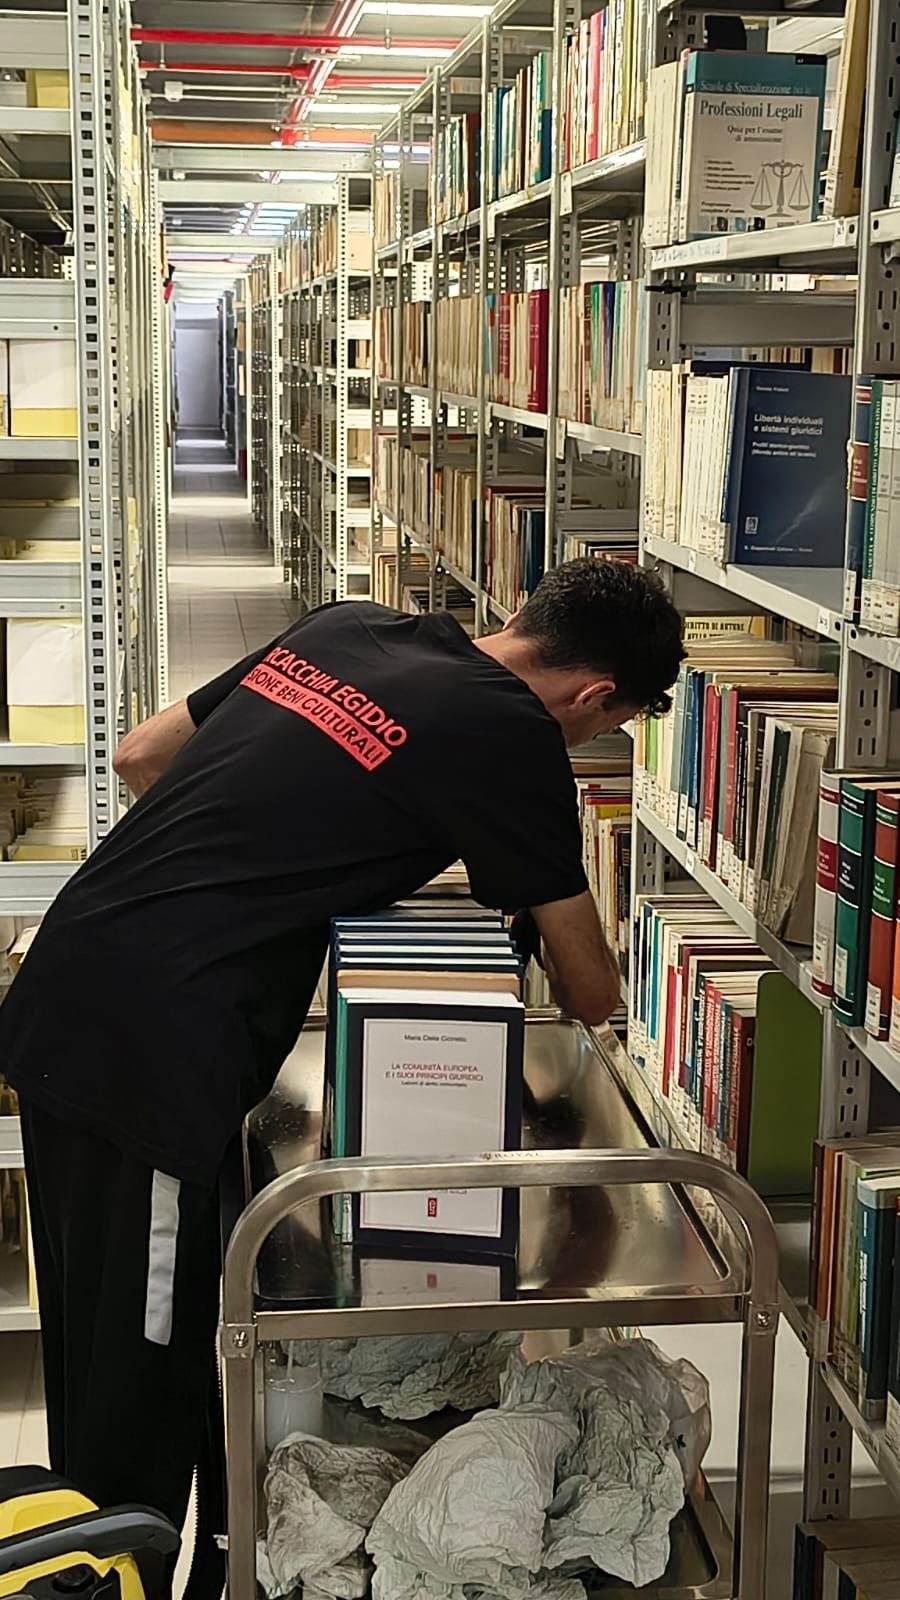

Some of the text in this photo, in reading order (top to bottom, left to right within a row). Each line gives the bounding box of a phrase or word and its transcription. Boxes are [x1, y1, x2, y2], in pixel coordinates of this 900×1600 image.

[700, 100, 803, 120] Professioni Legali
[754, 414, 823, 425] Libertà individuali
[761, 425, 789, 433] sistemi
[791, 427, 822, 436] giuridici
[330, 685, 408, 747] EGIDIO
[276, 684, 306, 704] BENI
[301, 697, 384, 764] CULTURALI
[391, 1062, 400, 1070] LA
[443, 1064, 478, 1073] EUROPEA
[397, 1071, 414, 1079] SUOI
[416, 1072, 448, 1081] PRINCIPI
[449, 1073, 484, 1082] GIURIDICI
